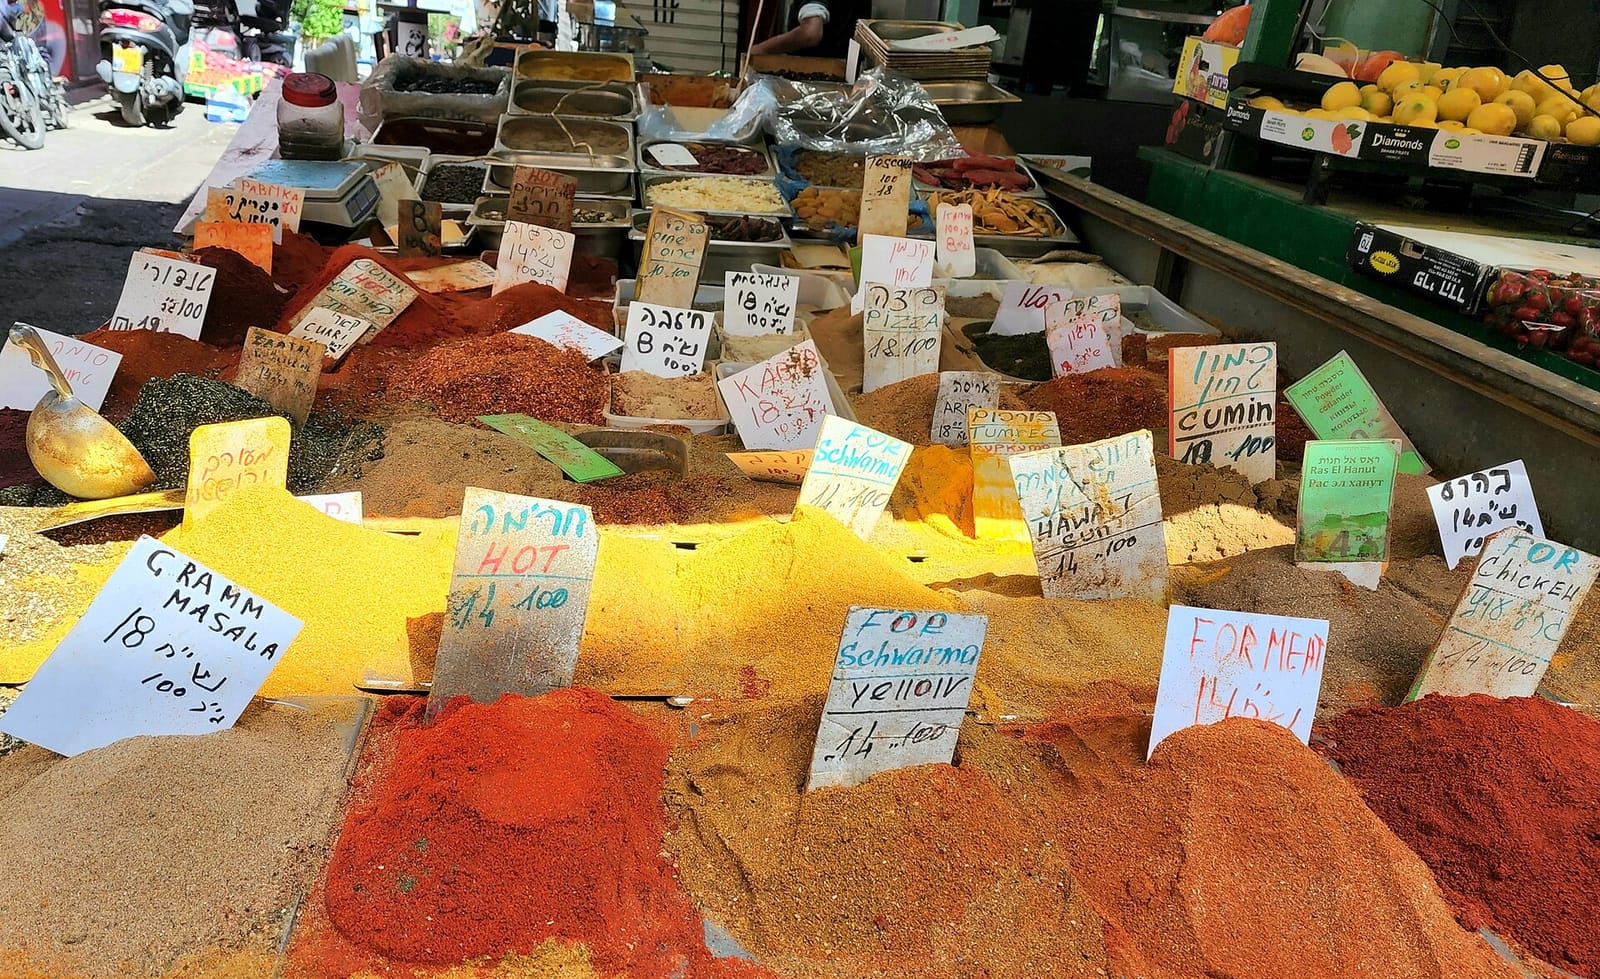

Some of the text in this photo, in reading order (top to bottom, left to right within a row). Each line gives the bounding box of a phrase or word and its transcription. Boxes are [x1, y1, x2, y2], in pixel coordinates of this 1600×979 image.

[1227, 106, 1251, 121] Diamonds
[1371, 132, 1424, 151] Diamonds
[510, 243, 528, 263] 14
[349, 273, 392, 297] HOT
[894, 266, 919, 287] טחון
[177, 298, 203, 320] 100
[737, 290, 757, 311] 18
[868, 286, 938, 311] פיצה
[641, 308, 705, 330] חילבה
[747, 313, 767, 328] 100
[303, 322, 348, 341] CURRI
[637, 331, 654, 355] 8
[664, 357, 691, 370] 100
[1193, 345, 1274, 385] כמון
[1197, 363, 1266, 408] טחון
[1314, 381, 1344, 404] Powder
[751, 399, 780, 428] 18
[1318, 388, 1355, 415] coriander
[972, 409, 1052, 423] כורכום
[845, 425, 903, 456] FOR
[1310, 465, 1377, 475] Ras El Hanut
[1318, 455, 1381, 466] ראס אל חנות
[1308, 478, 1328, 488] Рас
[1348, 478, 1384, 490] ханут
[476, 541, 570, 575] HOT
[1502, 535, 1580, 575] FOR
[103, 606, 156, 648] 18
[162, 589, 279, 661] MASALA
[856, 610, 948, 637] FOR
[837, 639, 980, 669] Schwarma
[1189, 616, 1327, 677] FOR MEAT
[141, 673, 187, 697] 100
